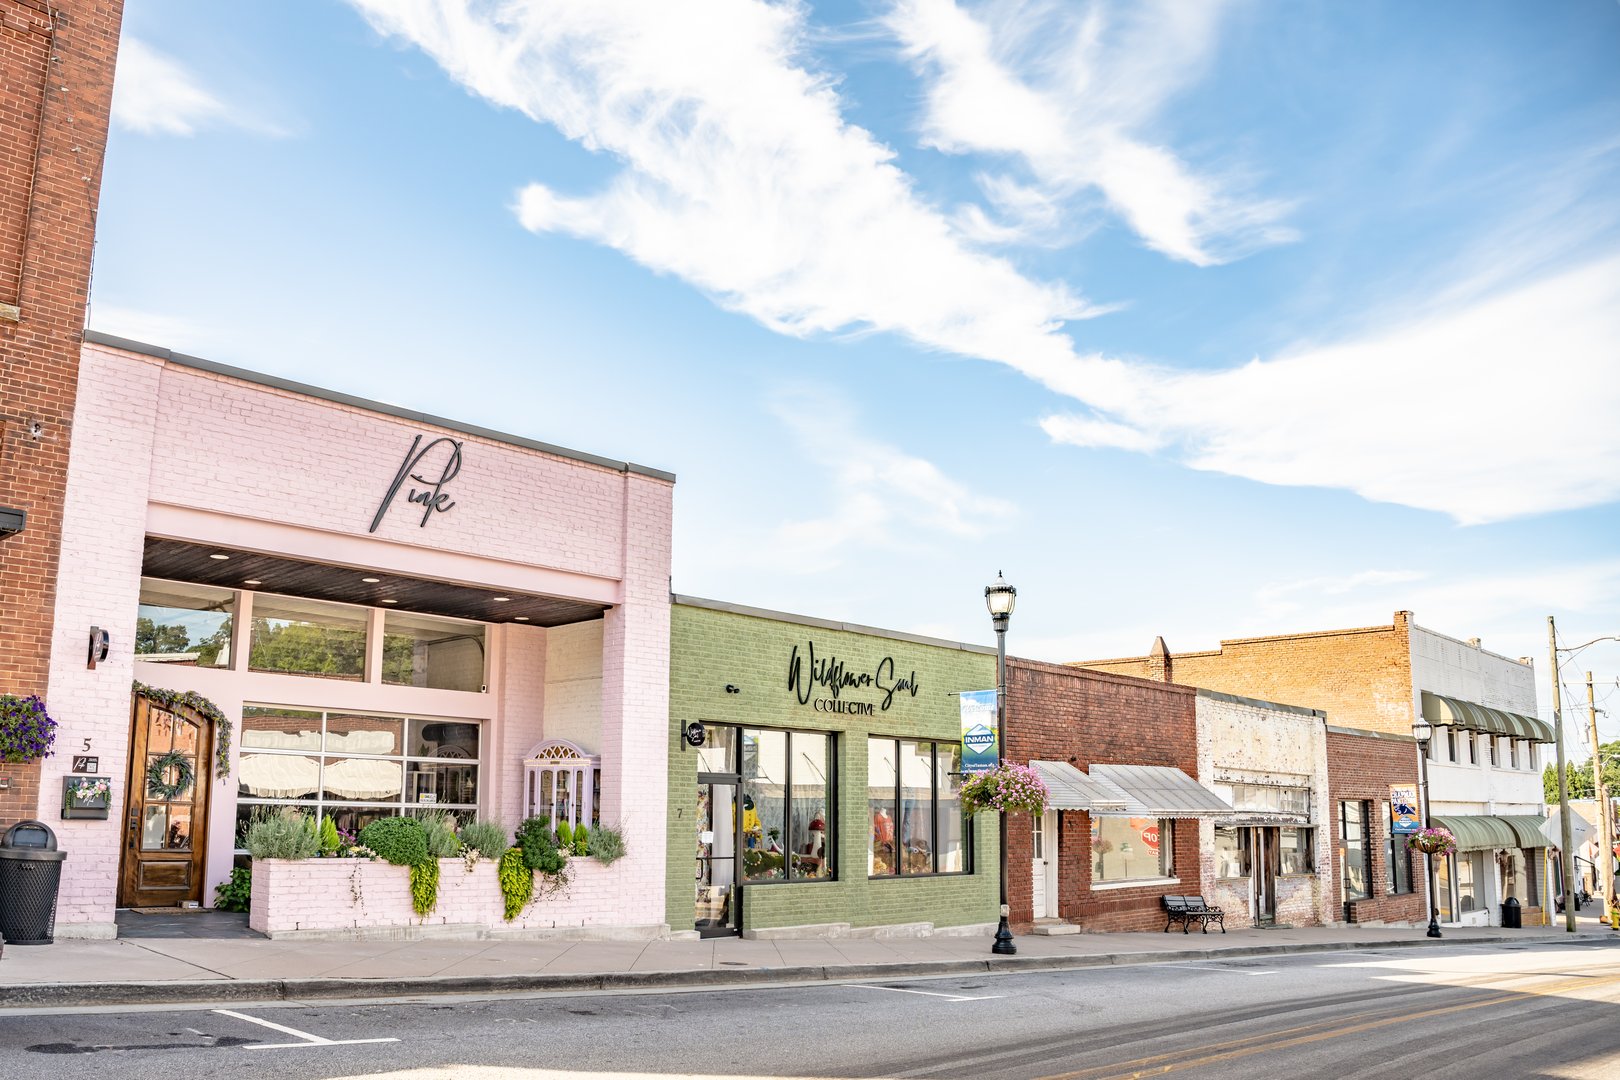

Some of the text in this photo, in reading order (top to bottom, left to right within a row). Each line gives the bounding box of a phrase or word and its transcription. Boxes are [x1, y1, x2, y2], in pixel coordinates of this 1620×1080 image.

[369, 434, 463, 533] Pink
[788, 640, 919, 711] Wildflower Soul
[814, 698, 875, 716] COLLECTIVE
[82, 737, 92, 752] 5
[965, 736, 994, 744] INMAN
[677, 808, 683, 819] 7
